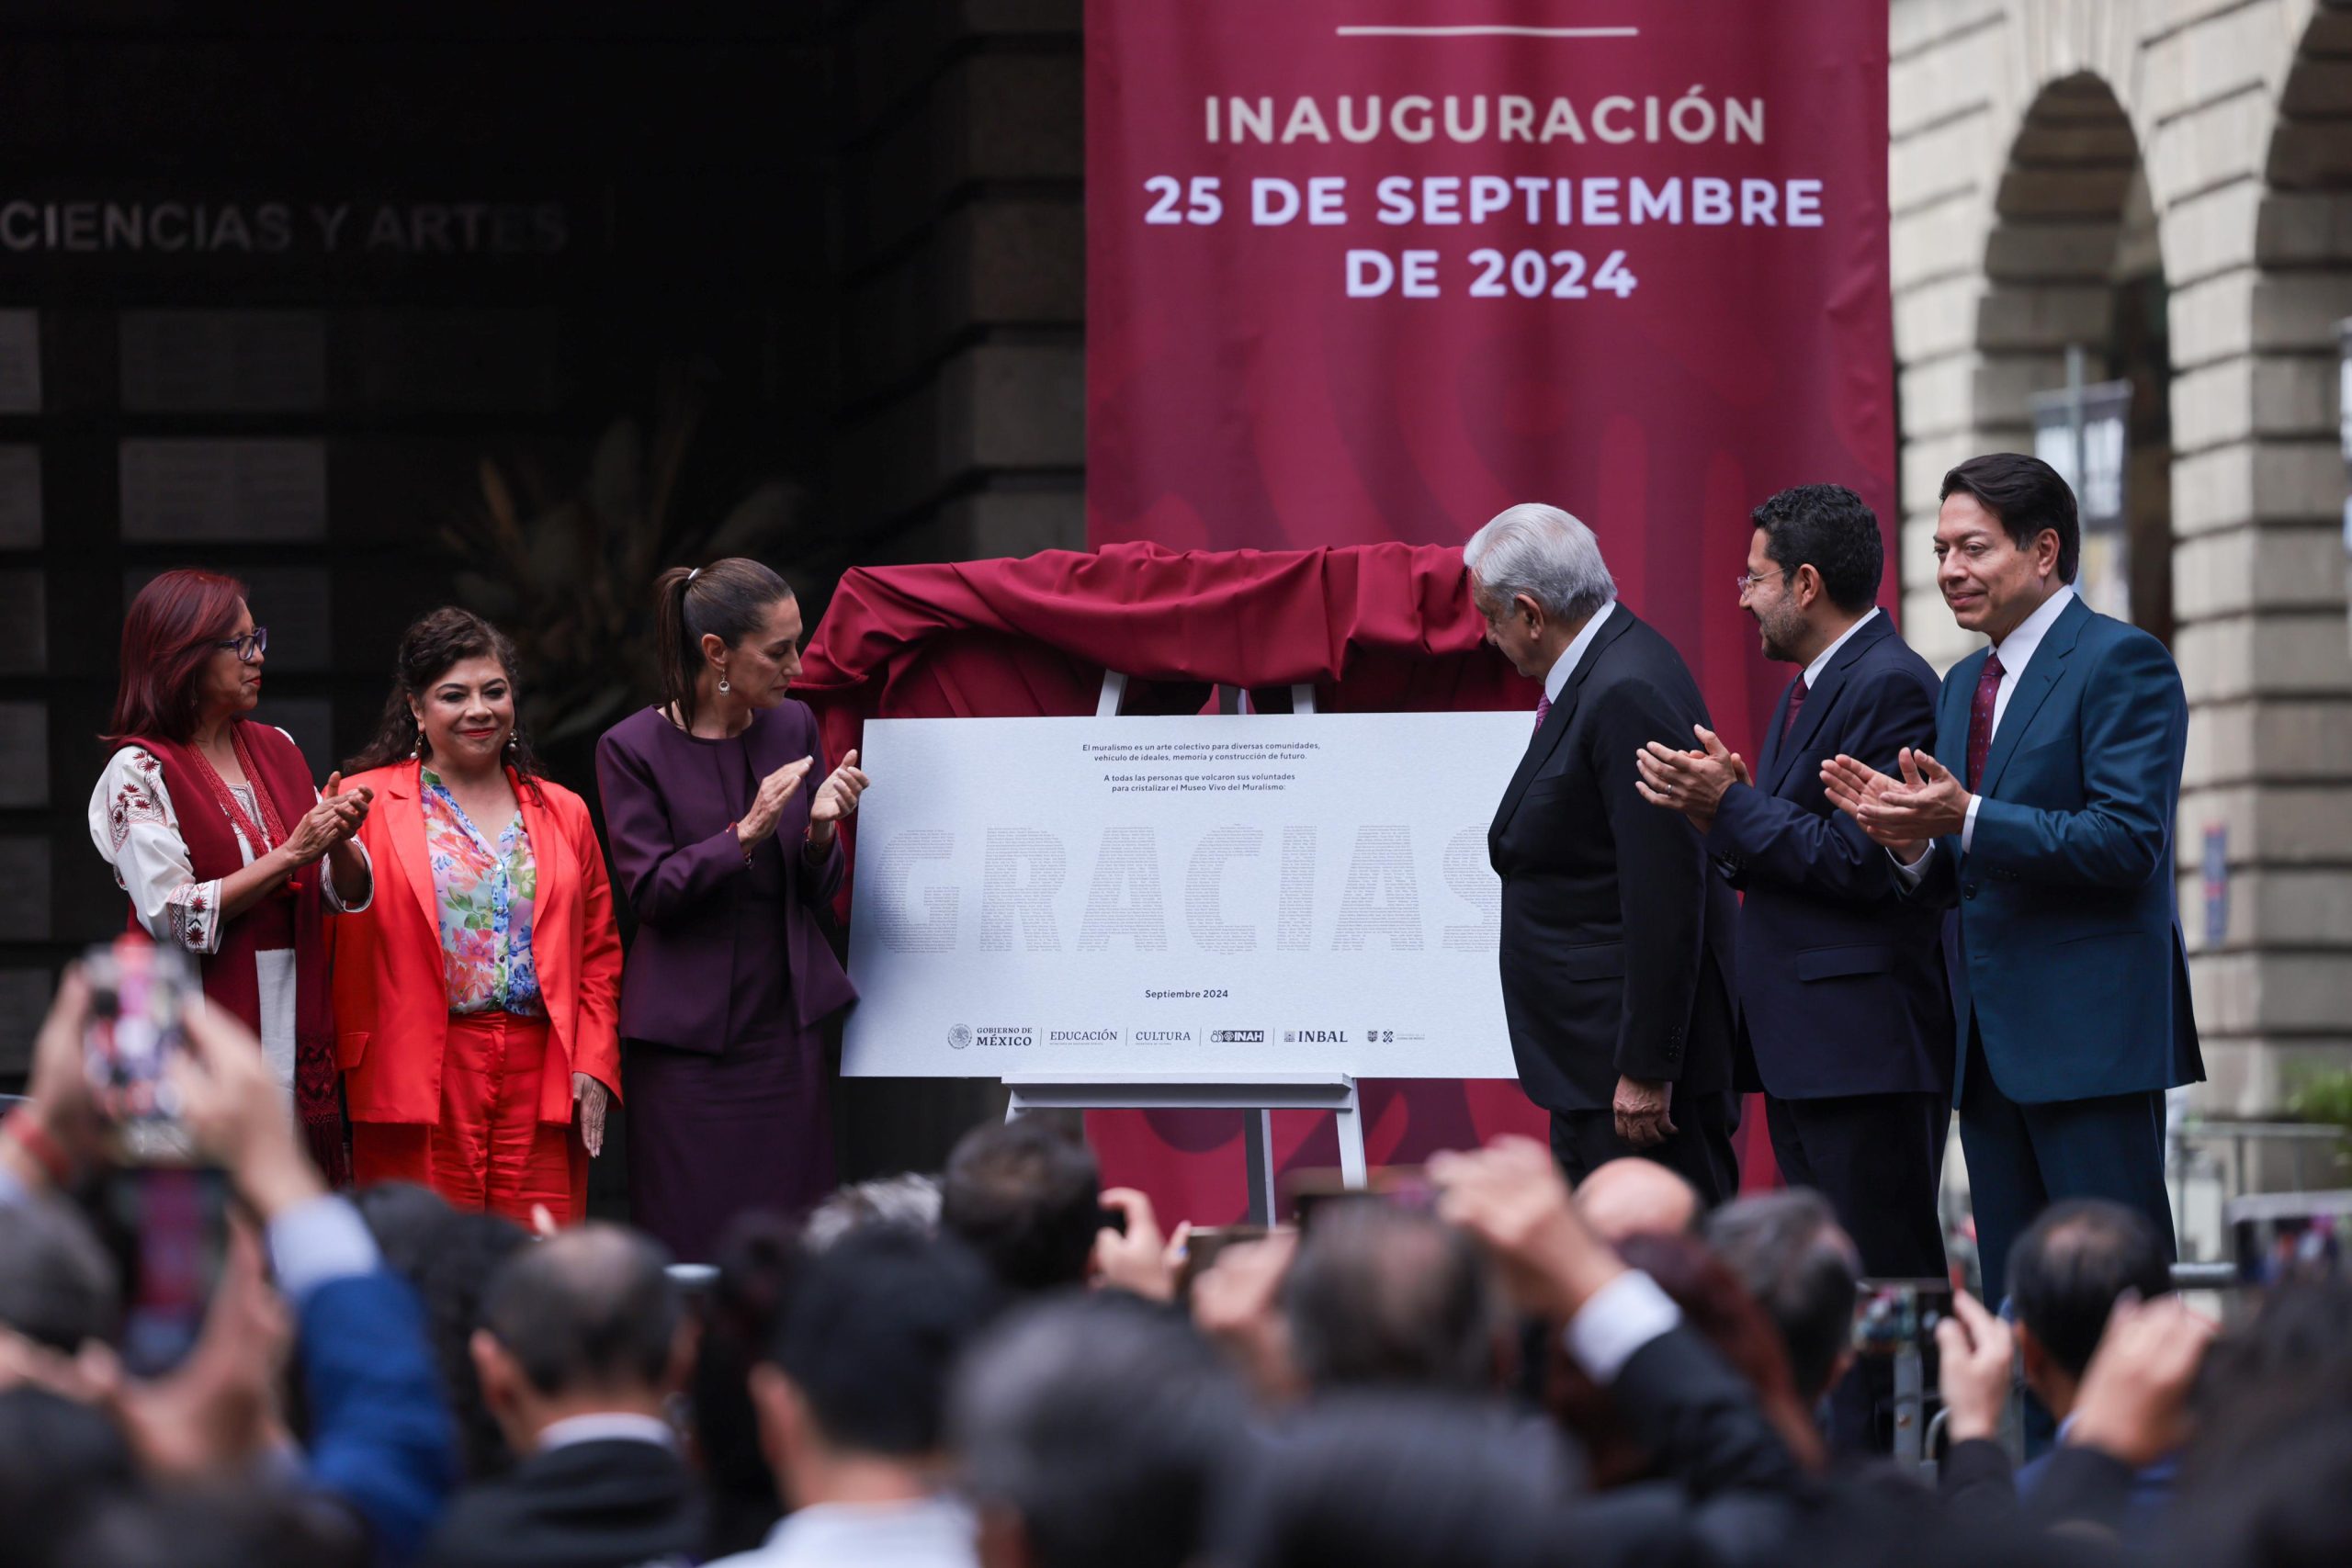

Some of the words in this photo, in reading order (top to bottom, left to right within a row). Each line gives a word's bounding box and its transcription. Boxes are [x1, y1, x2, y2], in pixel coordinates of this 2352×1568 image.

[1204, 85, 1765, 145] INAUGURACIÓN
[1143, 175, 1223, 225] 25
[1250, 176, 1348, 226] DE
[1376, 175, 1824, 228] SEPTIEMBRE
[0, 199, 291, 253] CIENCIAS
[311, 201, 350, 252] Y
[368, 202, 569, 254] ARTES
[1345, 252, 1441, 299] DE
[1468, 249, 1637, 299] 2024
[1091, 743, 1133, 751] muralismo
[1212, 743, 1229, 751] para
[1265, 742, 1320, 750] comunidades,
[1140, 754, 1170, 762] ideales,
[1215, 752, 1266, 761] construcción
[1147, 774, 1182, 783] personas
[1184, 774, 1200, 783] que
[1251, 773, 1295, 781] voluntades
[1130, 784, 1170, 792] cristalizar
[1180, 784, 1206, 792] Museo
[1208, 783, 1227, 791] Vivo
[1227, 783, 1240, 791] del
[1242, 783, 1285, 791] Muralismo:
[1145, 989, 1201, 999] Septiembre
[1203, 989, 1228, 998] 2024
[976, 1033, 1032, 1046] MÉXICO
[1050, 1029, 1118, 1041] EDUCACIÓN
[1136, 1032, 1192, 1041] CULTURA
[1234, 1031, 1263, 1042] INAH
[1298, 1031, 1348, 1043] INBAL
